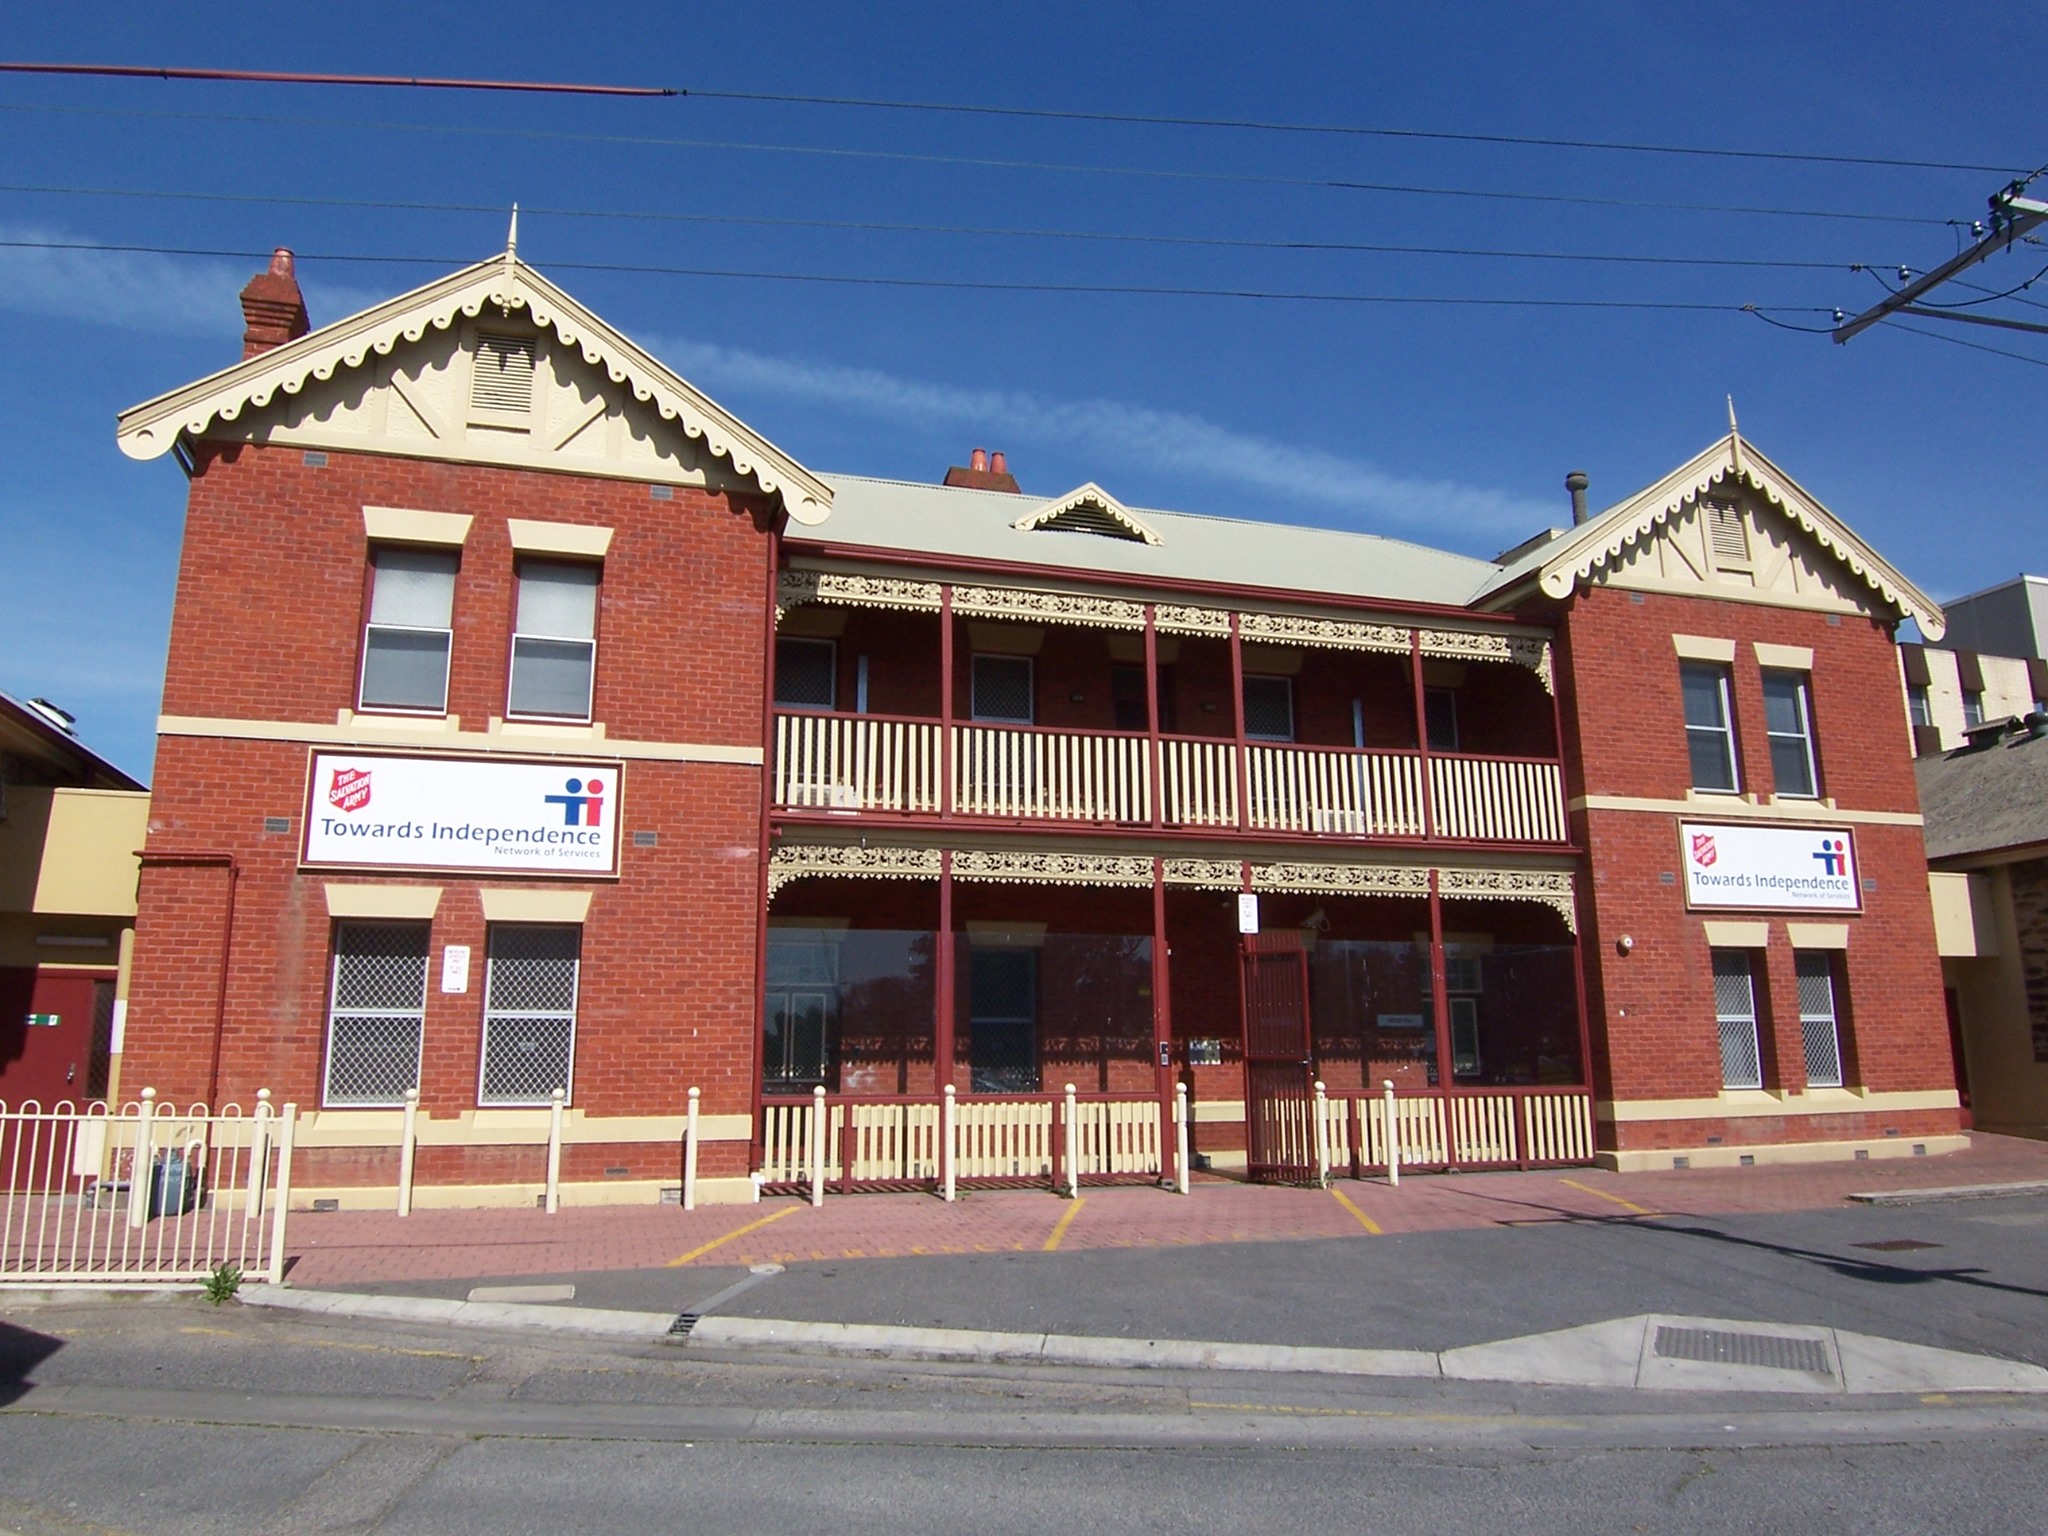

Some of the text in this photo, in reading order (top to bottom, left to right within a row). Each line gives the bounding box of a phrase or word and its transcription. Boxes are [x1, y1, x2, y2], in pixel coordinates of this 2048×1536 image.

[330, 773, 371, 803] SALVATION
[337, 769, 356, 787] THE
[342, 787, 369, 810] ARMY
[321, 818, 601, 846] Towards Independence
[494, 846, 600, 858] Network of Services
[1693, 871, 1849, 892] Towards Independence
